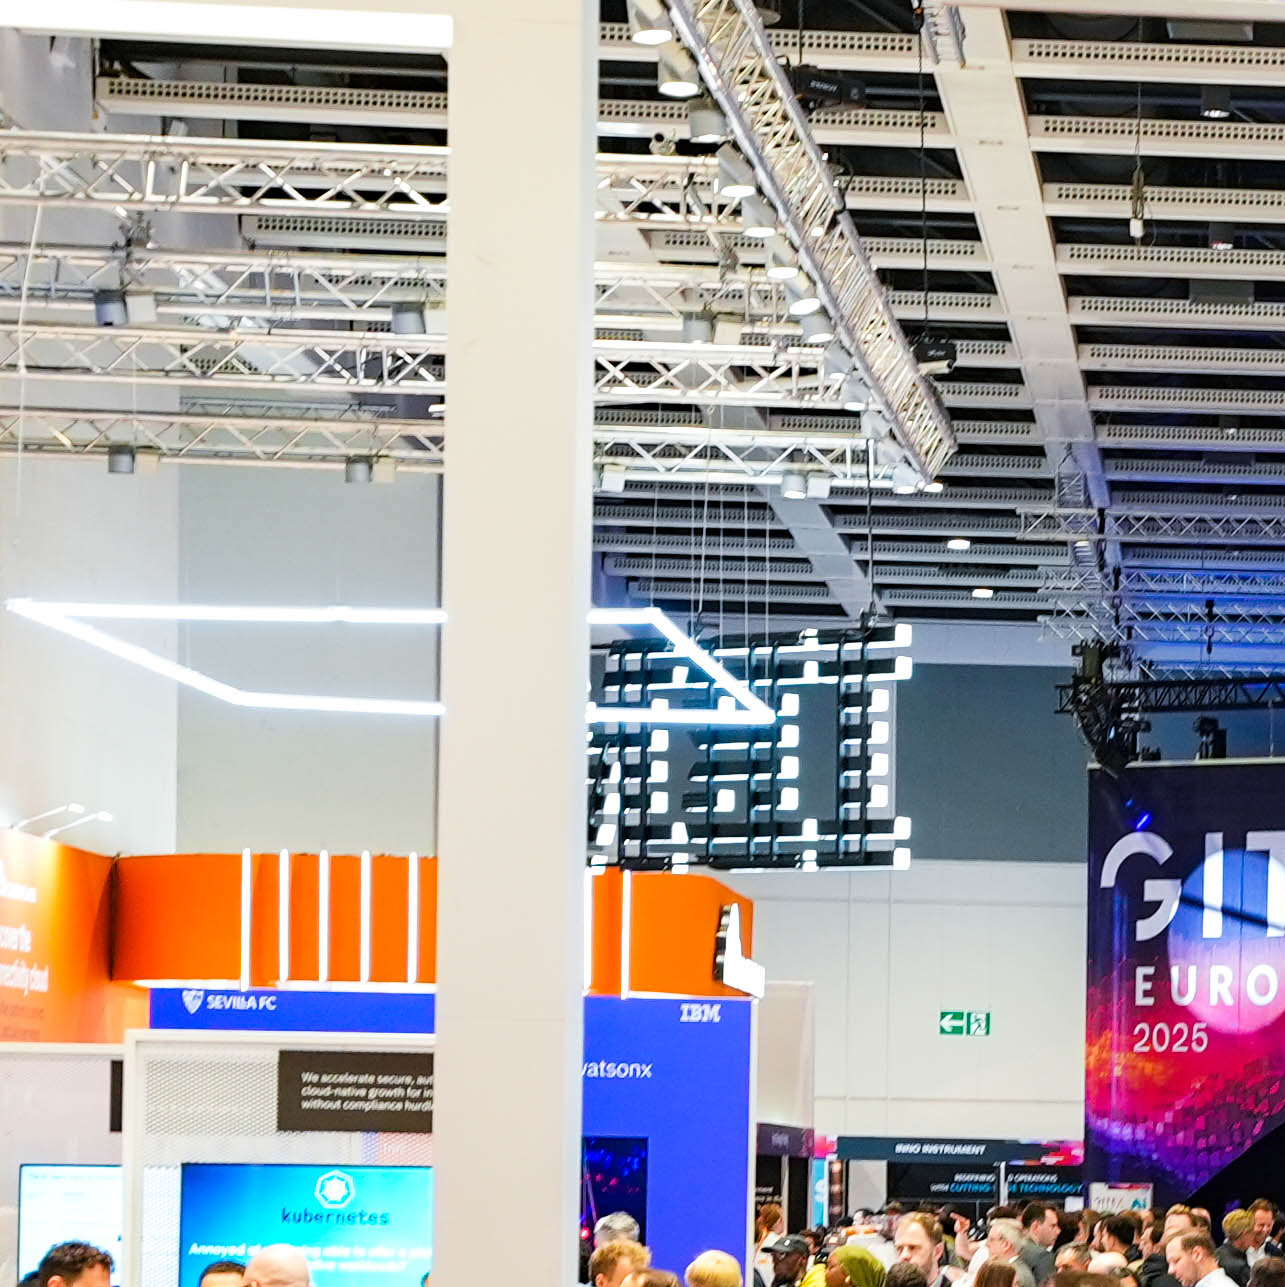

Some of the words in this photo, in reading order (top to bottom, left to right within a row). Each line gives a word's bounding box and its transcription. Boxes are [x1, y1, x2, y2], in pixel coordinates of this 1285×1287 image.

[206, 995, 257, 1010] SEVILLA
[258, 996, 277, 1011] FC
[680, 1003, 721, 1023] IBM
[1133, 1022, 1208, 1053] 2025
[301, 1072, 319, 1083] We
[895, 1143, 921, 1154] INNO
[922, 1144, 986, 1156] INSTRUMENT
[1020, 1183, 1083, 1194] TECHNOLOGY
[281, 1207, 391, 1225] kubernetes
[189, 1243, 246, 1258] Annoyed
